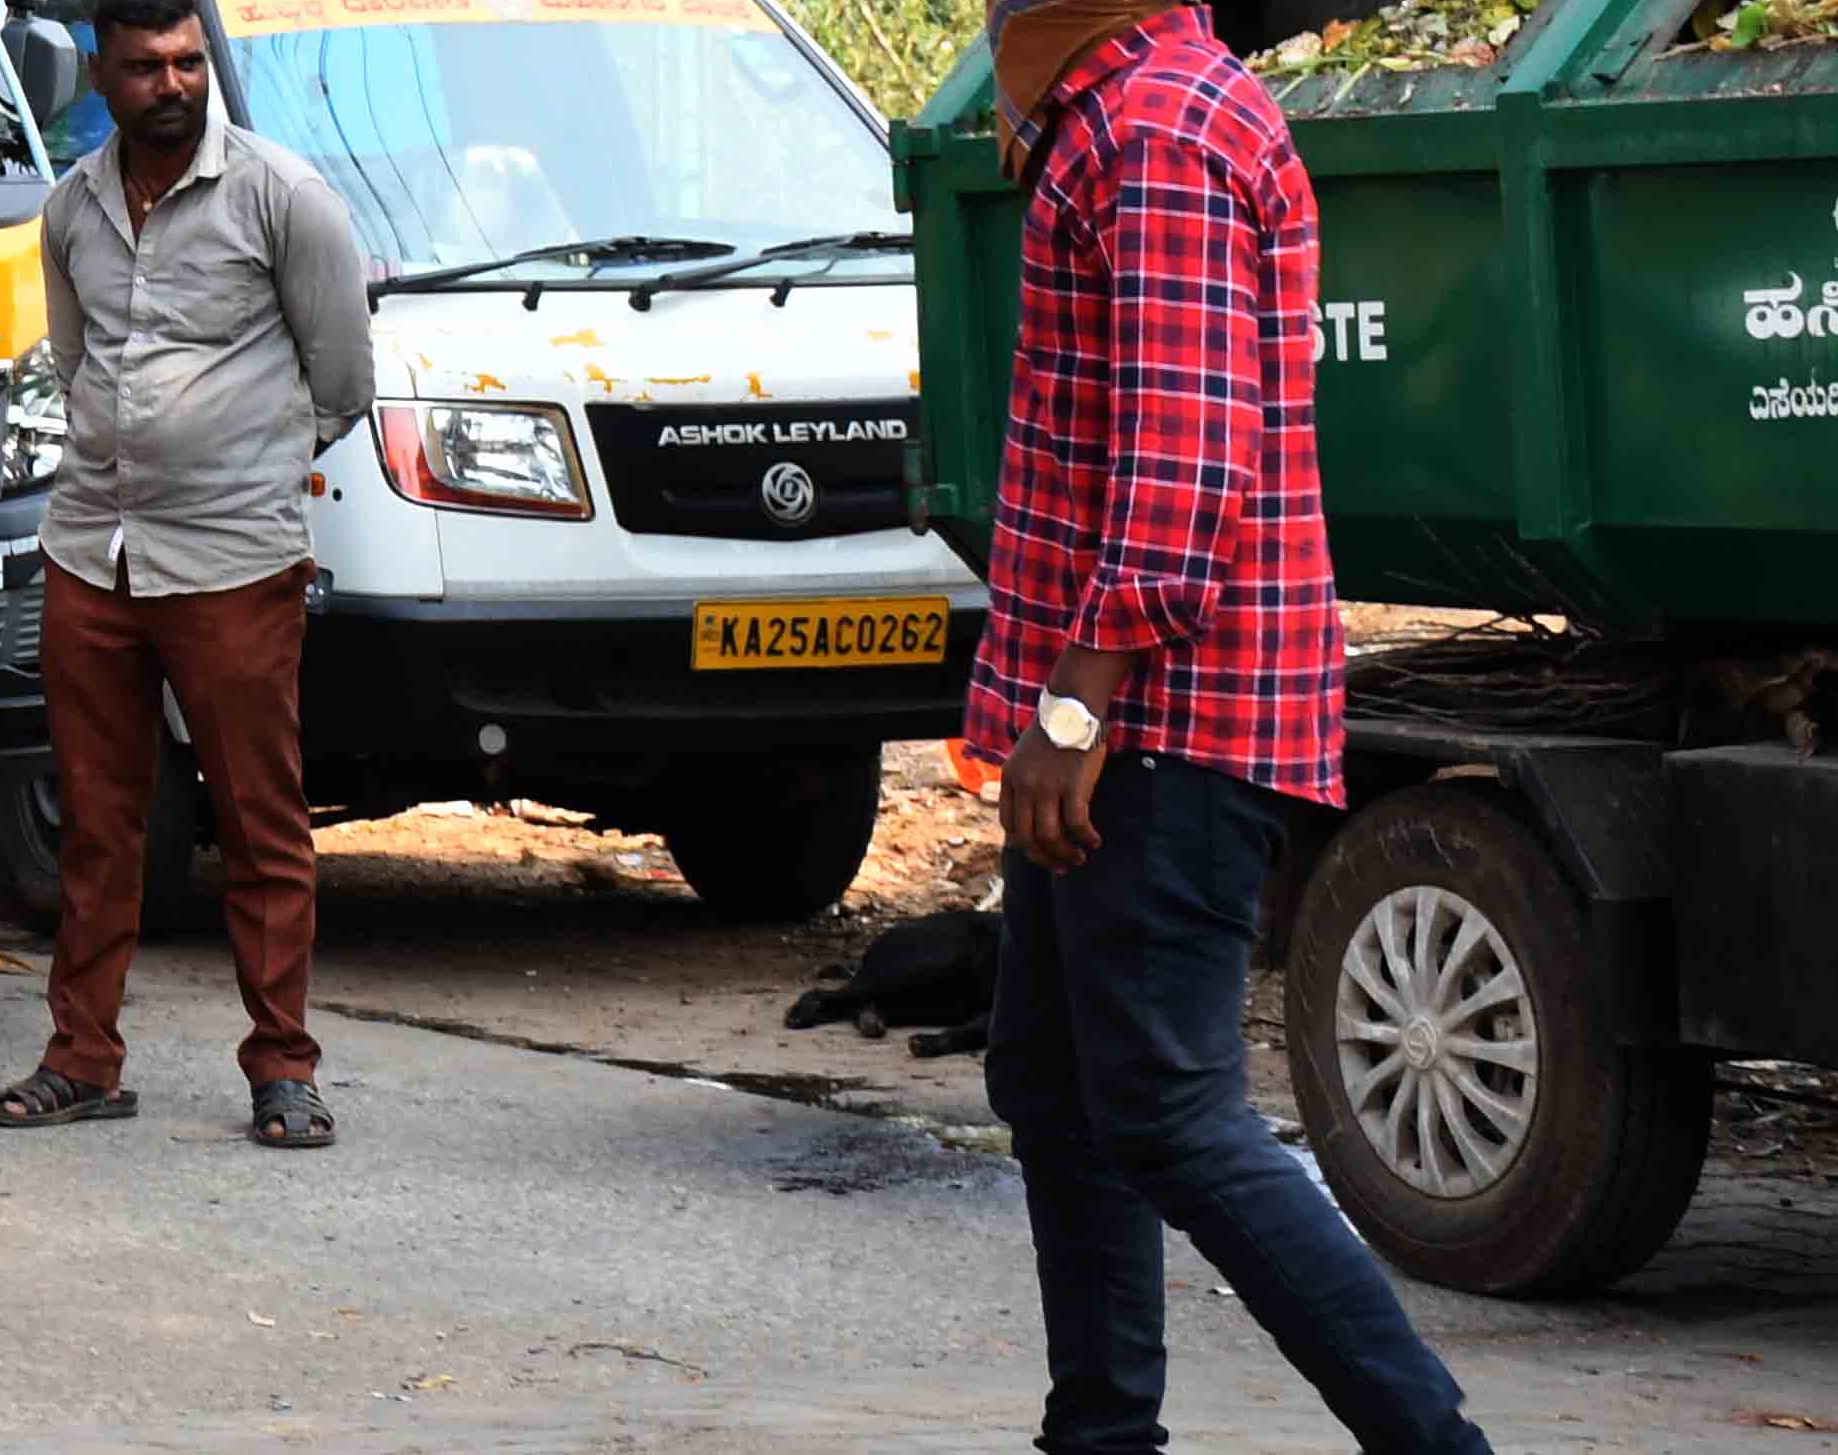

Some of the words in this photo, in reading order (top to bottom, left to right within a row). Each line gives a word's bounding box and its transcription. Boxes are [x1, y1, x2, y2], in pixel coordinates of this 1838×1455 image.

[658, 423, 768, 446] ASHOK
[773, 419, 907, 443] LEYLAND
[720, 613, 944, 657] KA25AC0262
